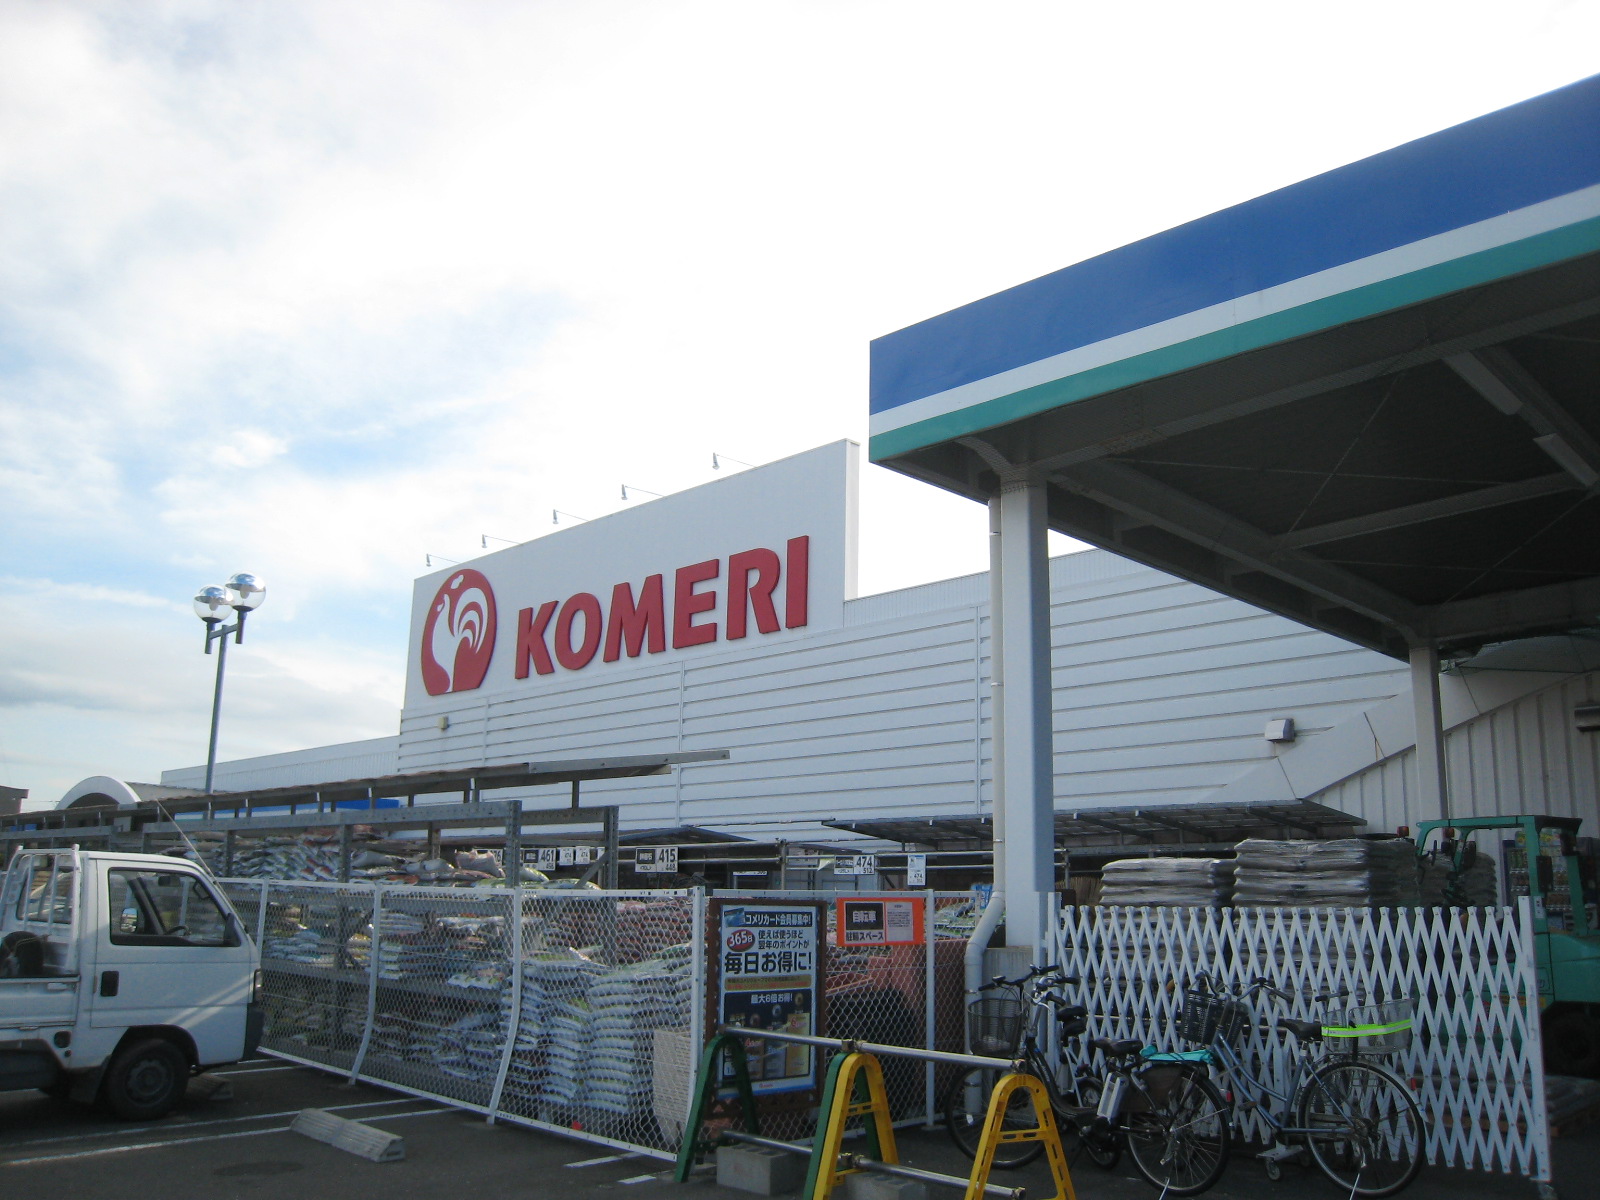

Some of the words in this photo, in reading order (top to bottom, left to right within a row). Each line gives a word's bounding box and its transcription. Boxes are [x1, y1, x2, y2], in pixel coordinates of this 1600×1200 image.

[515, 535, 809, 680] KOMERI
[541, 849, 554, 862] 461
[659, 848, 676, 863] 415
[857, 856, 873, 867] 474
[853, 910, 876, 923] 自転車
[728, 930, 753, 947] 365日
[758, 929, 804, 940] 使えば使うほど
[846, 931, 884, 942] 駐輪スペース
[758, 940, 809, 950] 翌年のポイントが
[724, 951, 812, 975] 毎日お得に!
